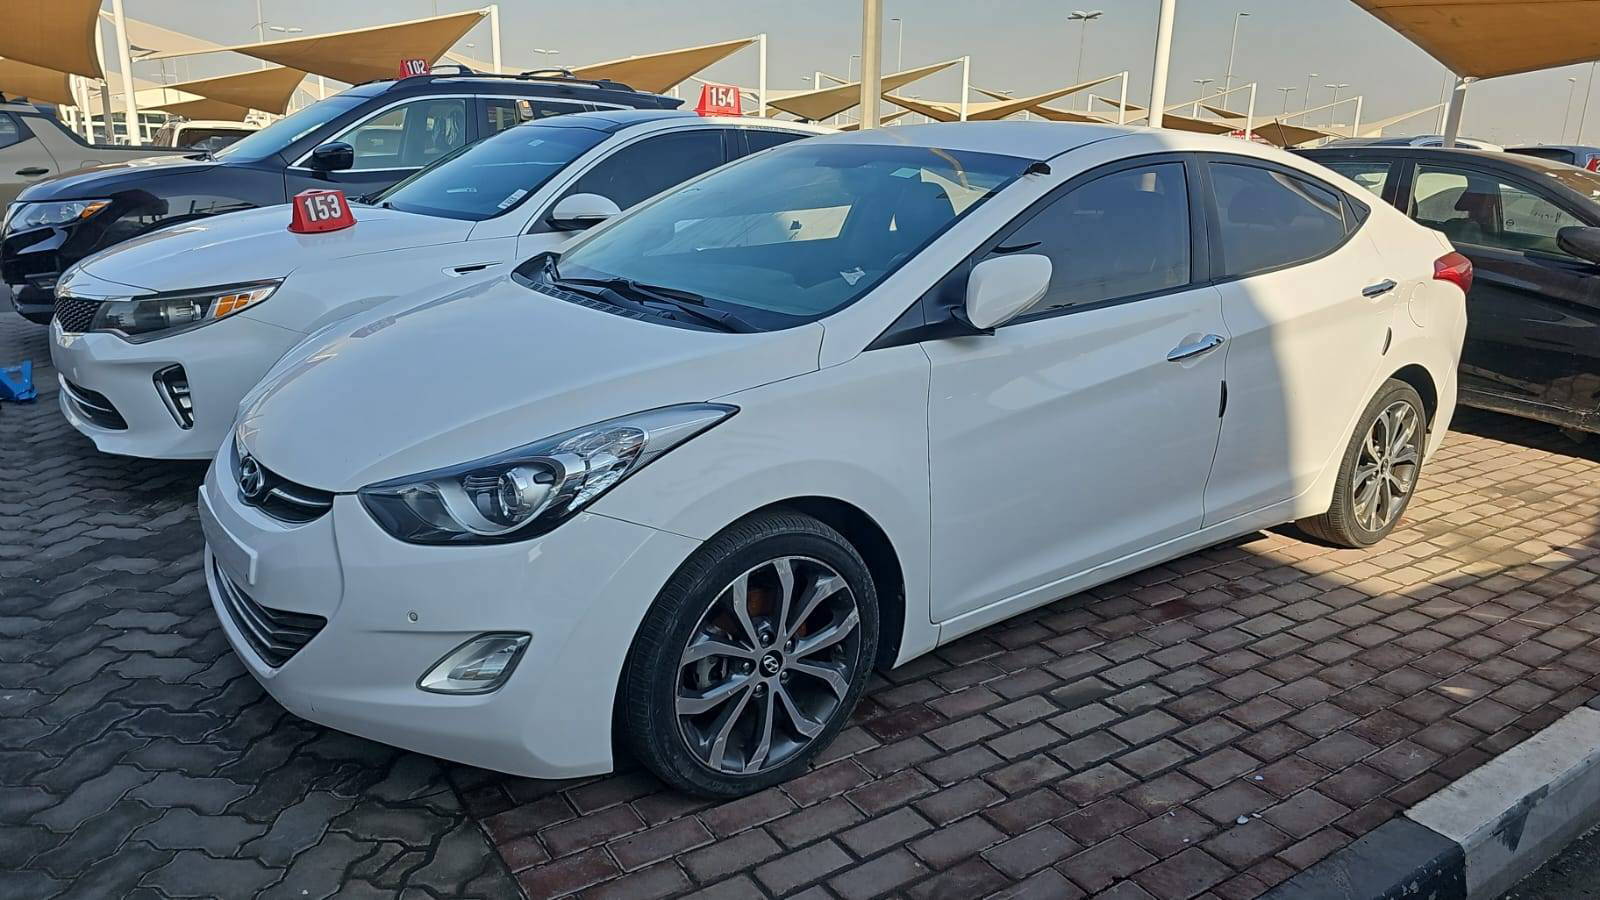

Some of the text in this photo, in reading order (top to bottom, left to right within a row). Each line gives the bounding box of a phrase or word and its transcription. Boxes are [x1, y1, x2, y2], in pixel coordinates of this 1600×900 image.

[406, 60, 427, 75] 102
[710, 87, 735, 107] 154
[305, 194, 341, 222] 153
